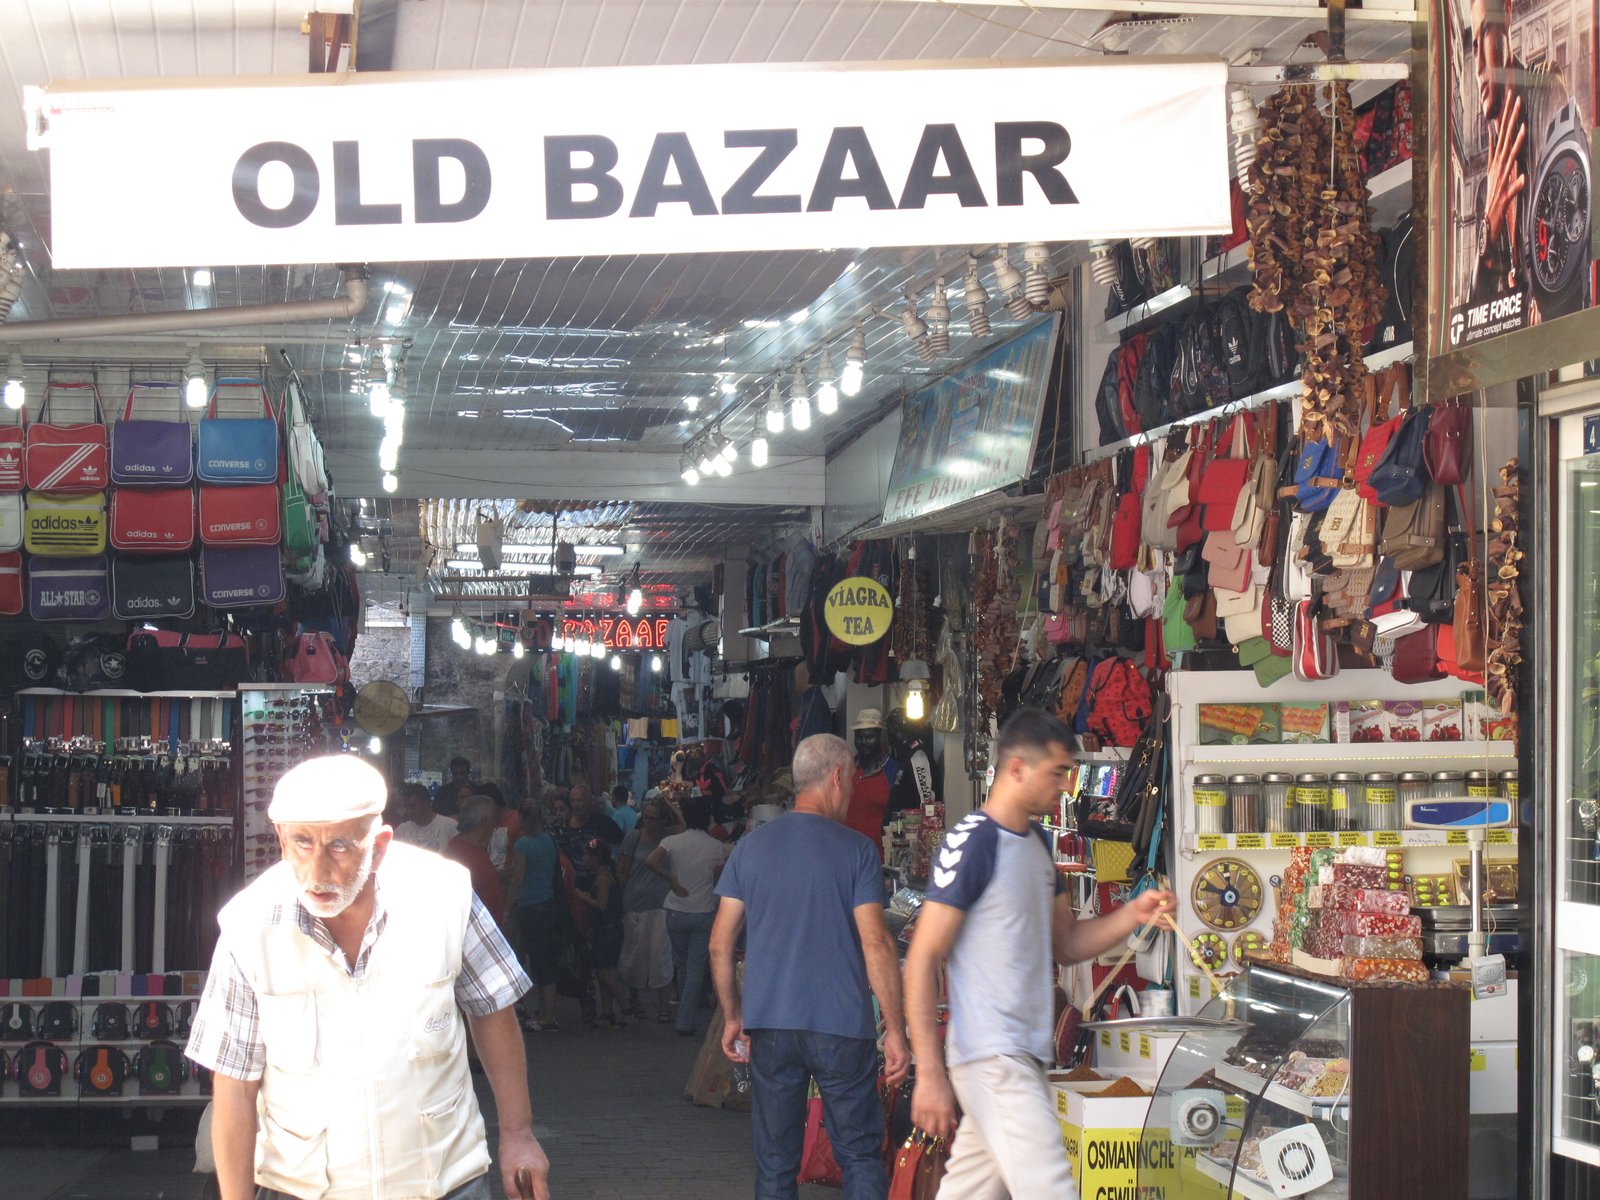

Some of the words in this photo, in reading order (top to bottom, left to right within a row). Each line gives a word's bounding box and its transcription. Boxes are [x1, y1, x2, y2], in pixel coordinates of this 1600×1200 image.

[232, 138, 491, 228] OLD
[544, 120, 1079, 220] BAZAAR
[1467, 303, 1489, 328] TIME
[1490, 292, 1522, 321] FORCE
[1466, 326, 1483, 341] ultimate
[1483, 320, 1502, 336] concept
[1502, 316, 1521, 330] watches
[125, 464, 156, 472] adidas
[208, 459, 250, 469] CONVERSE
[893, 481, 925, 510] EFE
[31, 516, 78, 530] adidas
[210, 522, 252, 532] CONVERSE
[127, 530, 158, 538] adidas
[40, 590, 55, 606] ALL
[64, 590, 85, 606] STAR
[212, 588, 254, 598] CONVERSE
[127, 597, 161, 608] adidas
[843, 616, 875, 635] TEA
[1087, 1141, 1175, 1169] OSMANINCHE
